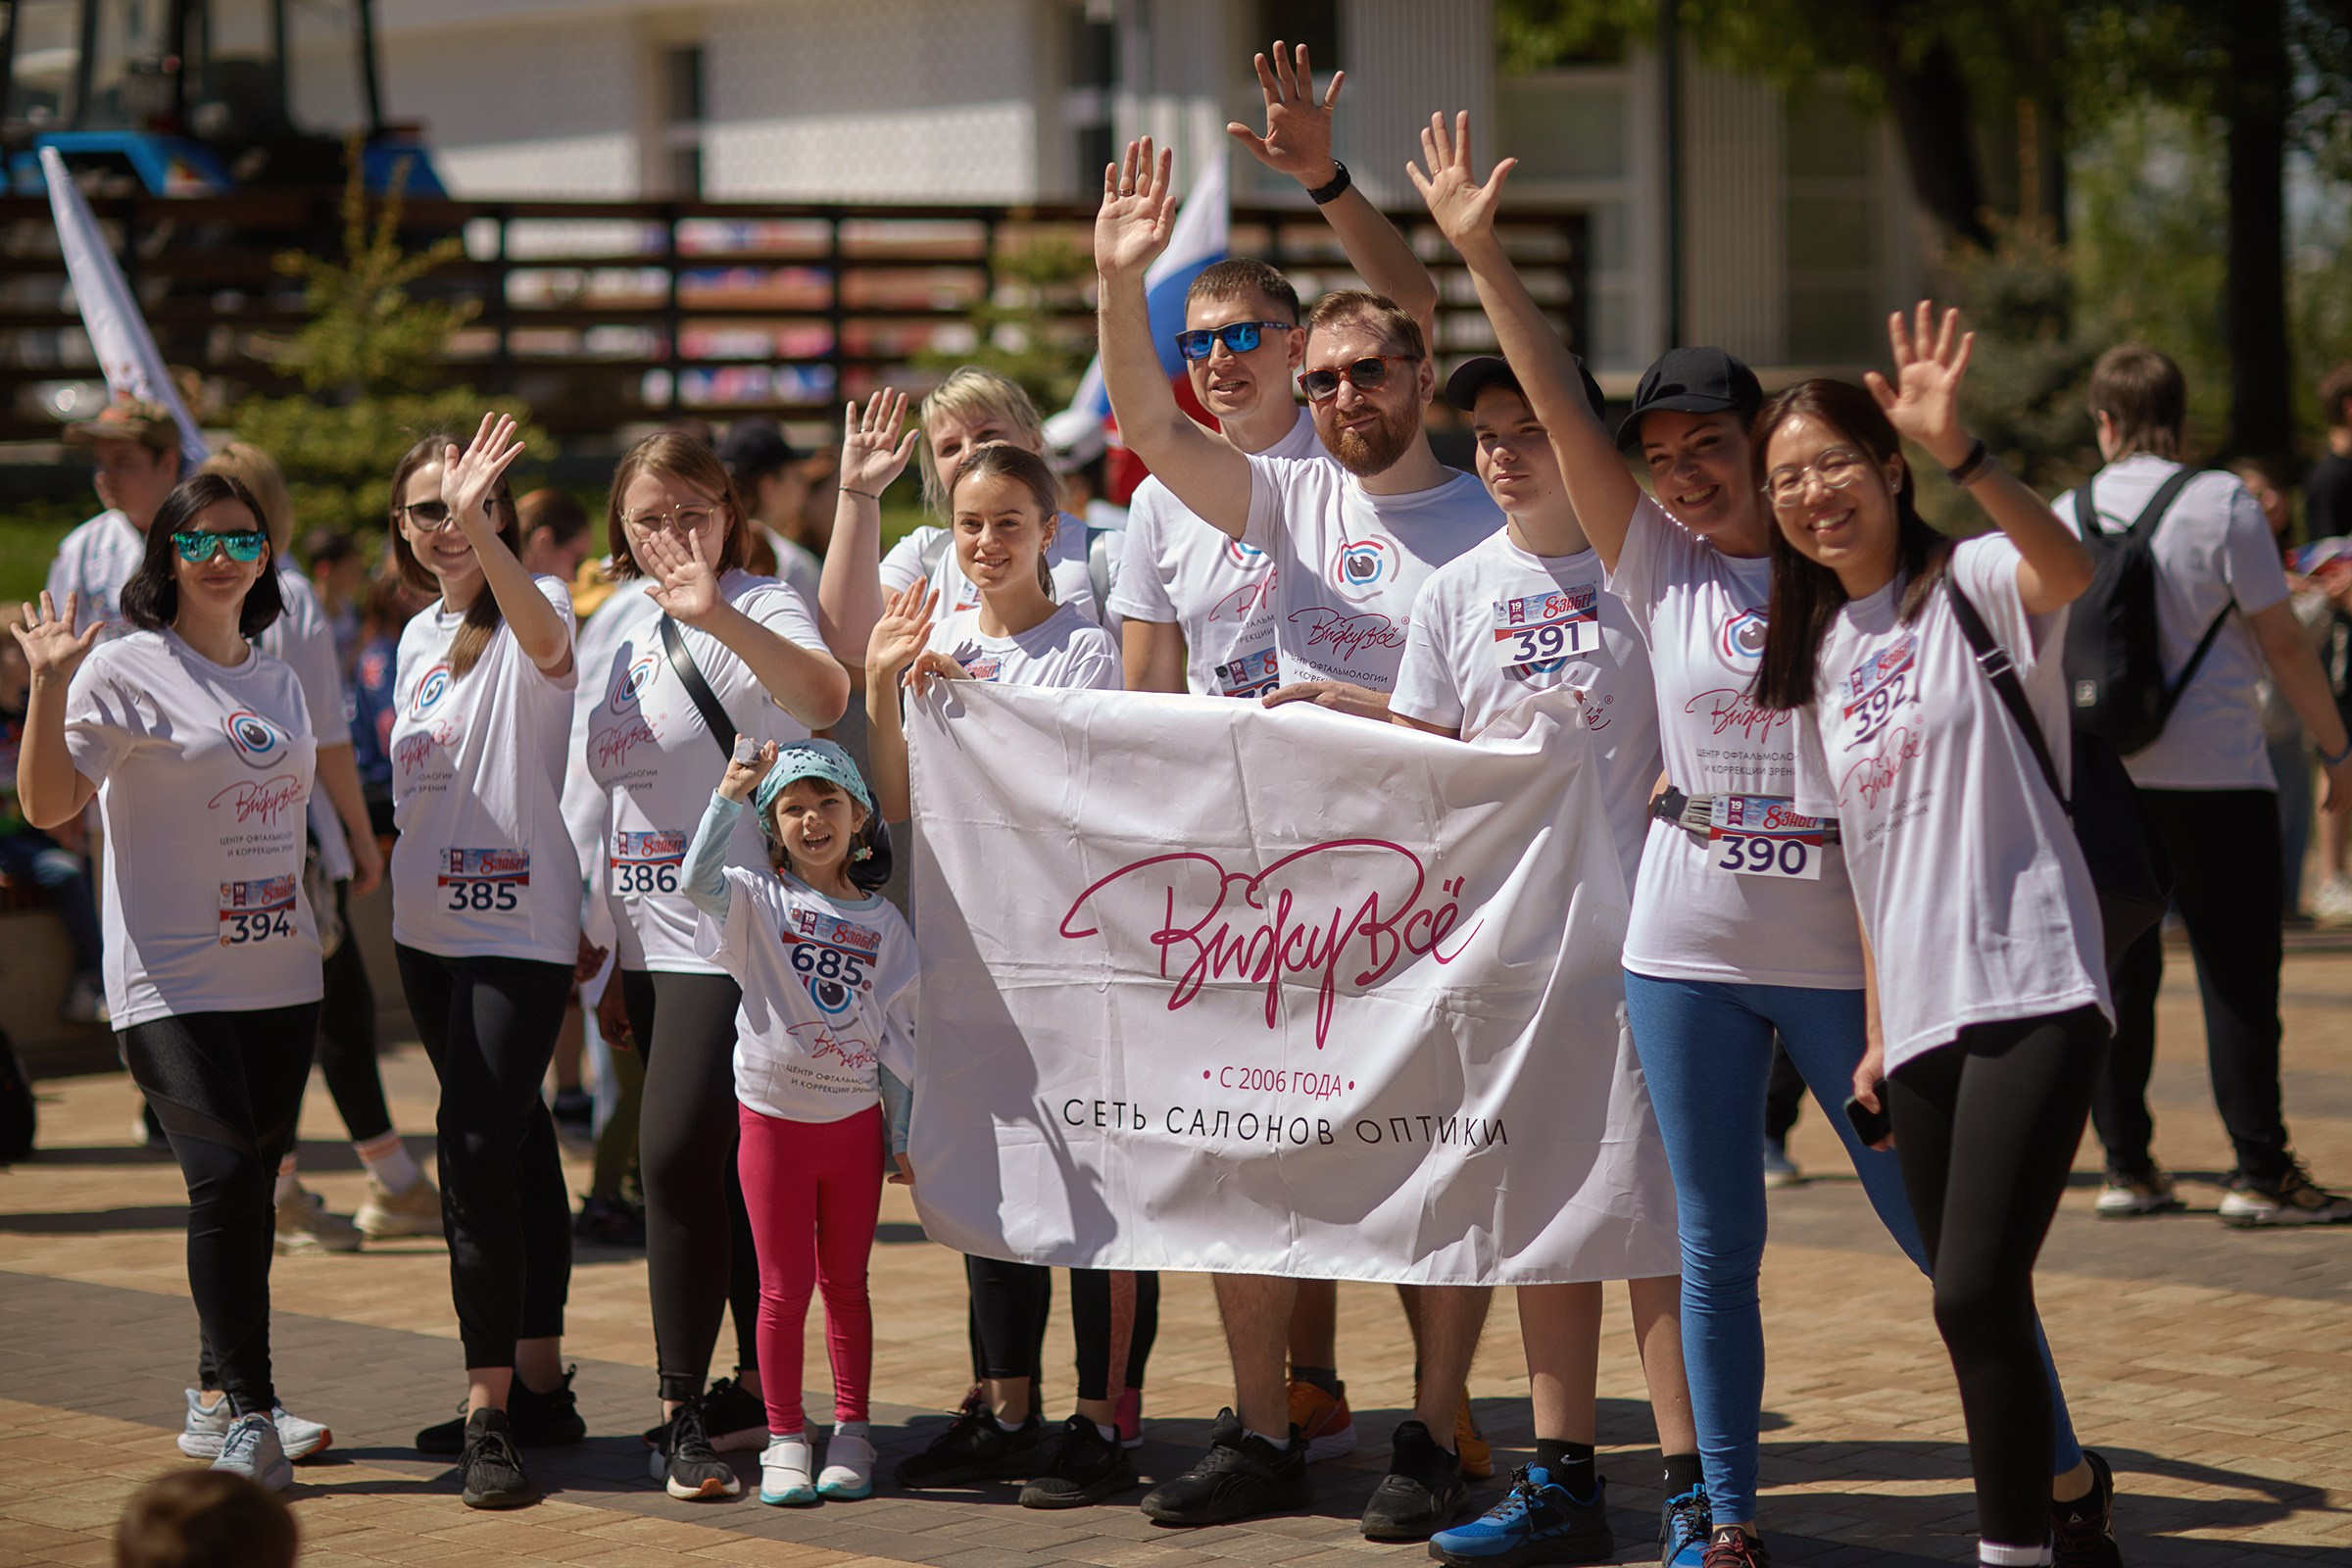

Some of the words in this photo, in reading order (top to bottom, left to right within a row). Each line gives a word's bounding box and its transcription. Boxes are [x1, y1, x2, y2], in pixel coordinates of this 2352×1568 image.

[1513, 621, 1580, 662] 391
[1309, 661, 1389, 684] ОФТАЛЬМОЛОГИИ
[1854, 673, 1908, 738] 392
[1711, 764, 1766, 775] КОРРЕКЦИИ
[1769, 766, 1795, 776] ЗРЕН
[1722, 751, 1795, 761] ОФТАЛЬМОЛО
[1718, 835, 1807, 875] 390
[618, 864, 677, 893] 386
[448, 882, 517, 910] 385
[229, 908, 290, 944] 394
[805, 912, 815, 922] 19
[791, 943, 864, 986] 685
[787, 1064, 813, 1077] ЦЕНТР
[1218, 1065, 1234, 1088] С
[1239, 1067, 1287, 1094] 2006
[1292, 1071, 1343, 1102] ГОДА
[801, 1081, 850, 1094] КОРРЕКЦИИ
[1063, 1099, 1147, 1131] СЕТЬ
[1166, 1106, 1335, 1146] САЛОНОВ
[1355, 1116, 1509, 1146] ОПТИКИ
